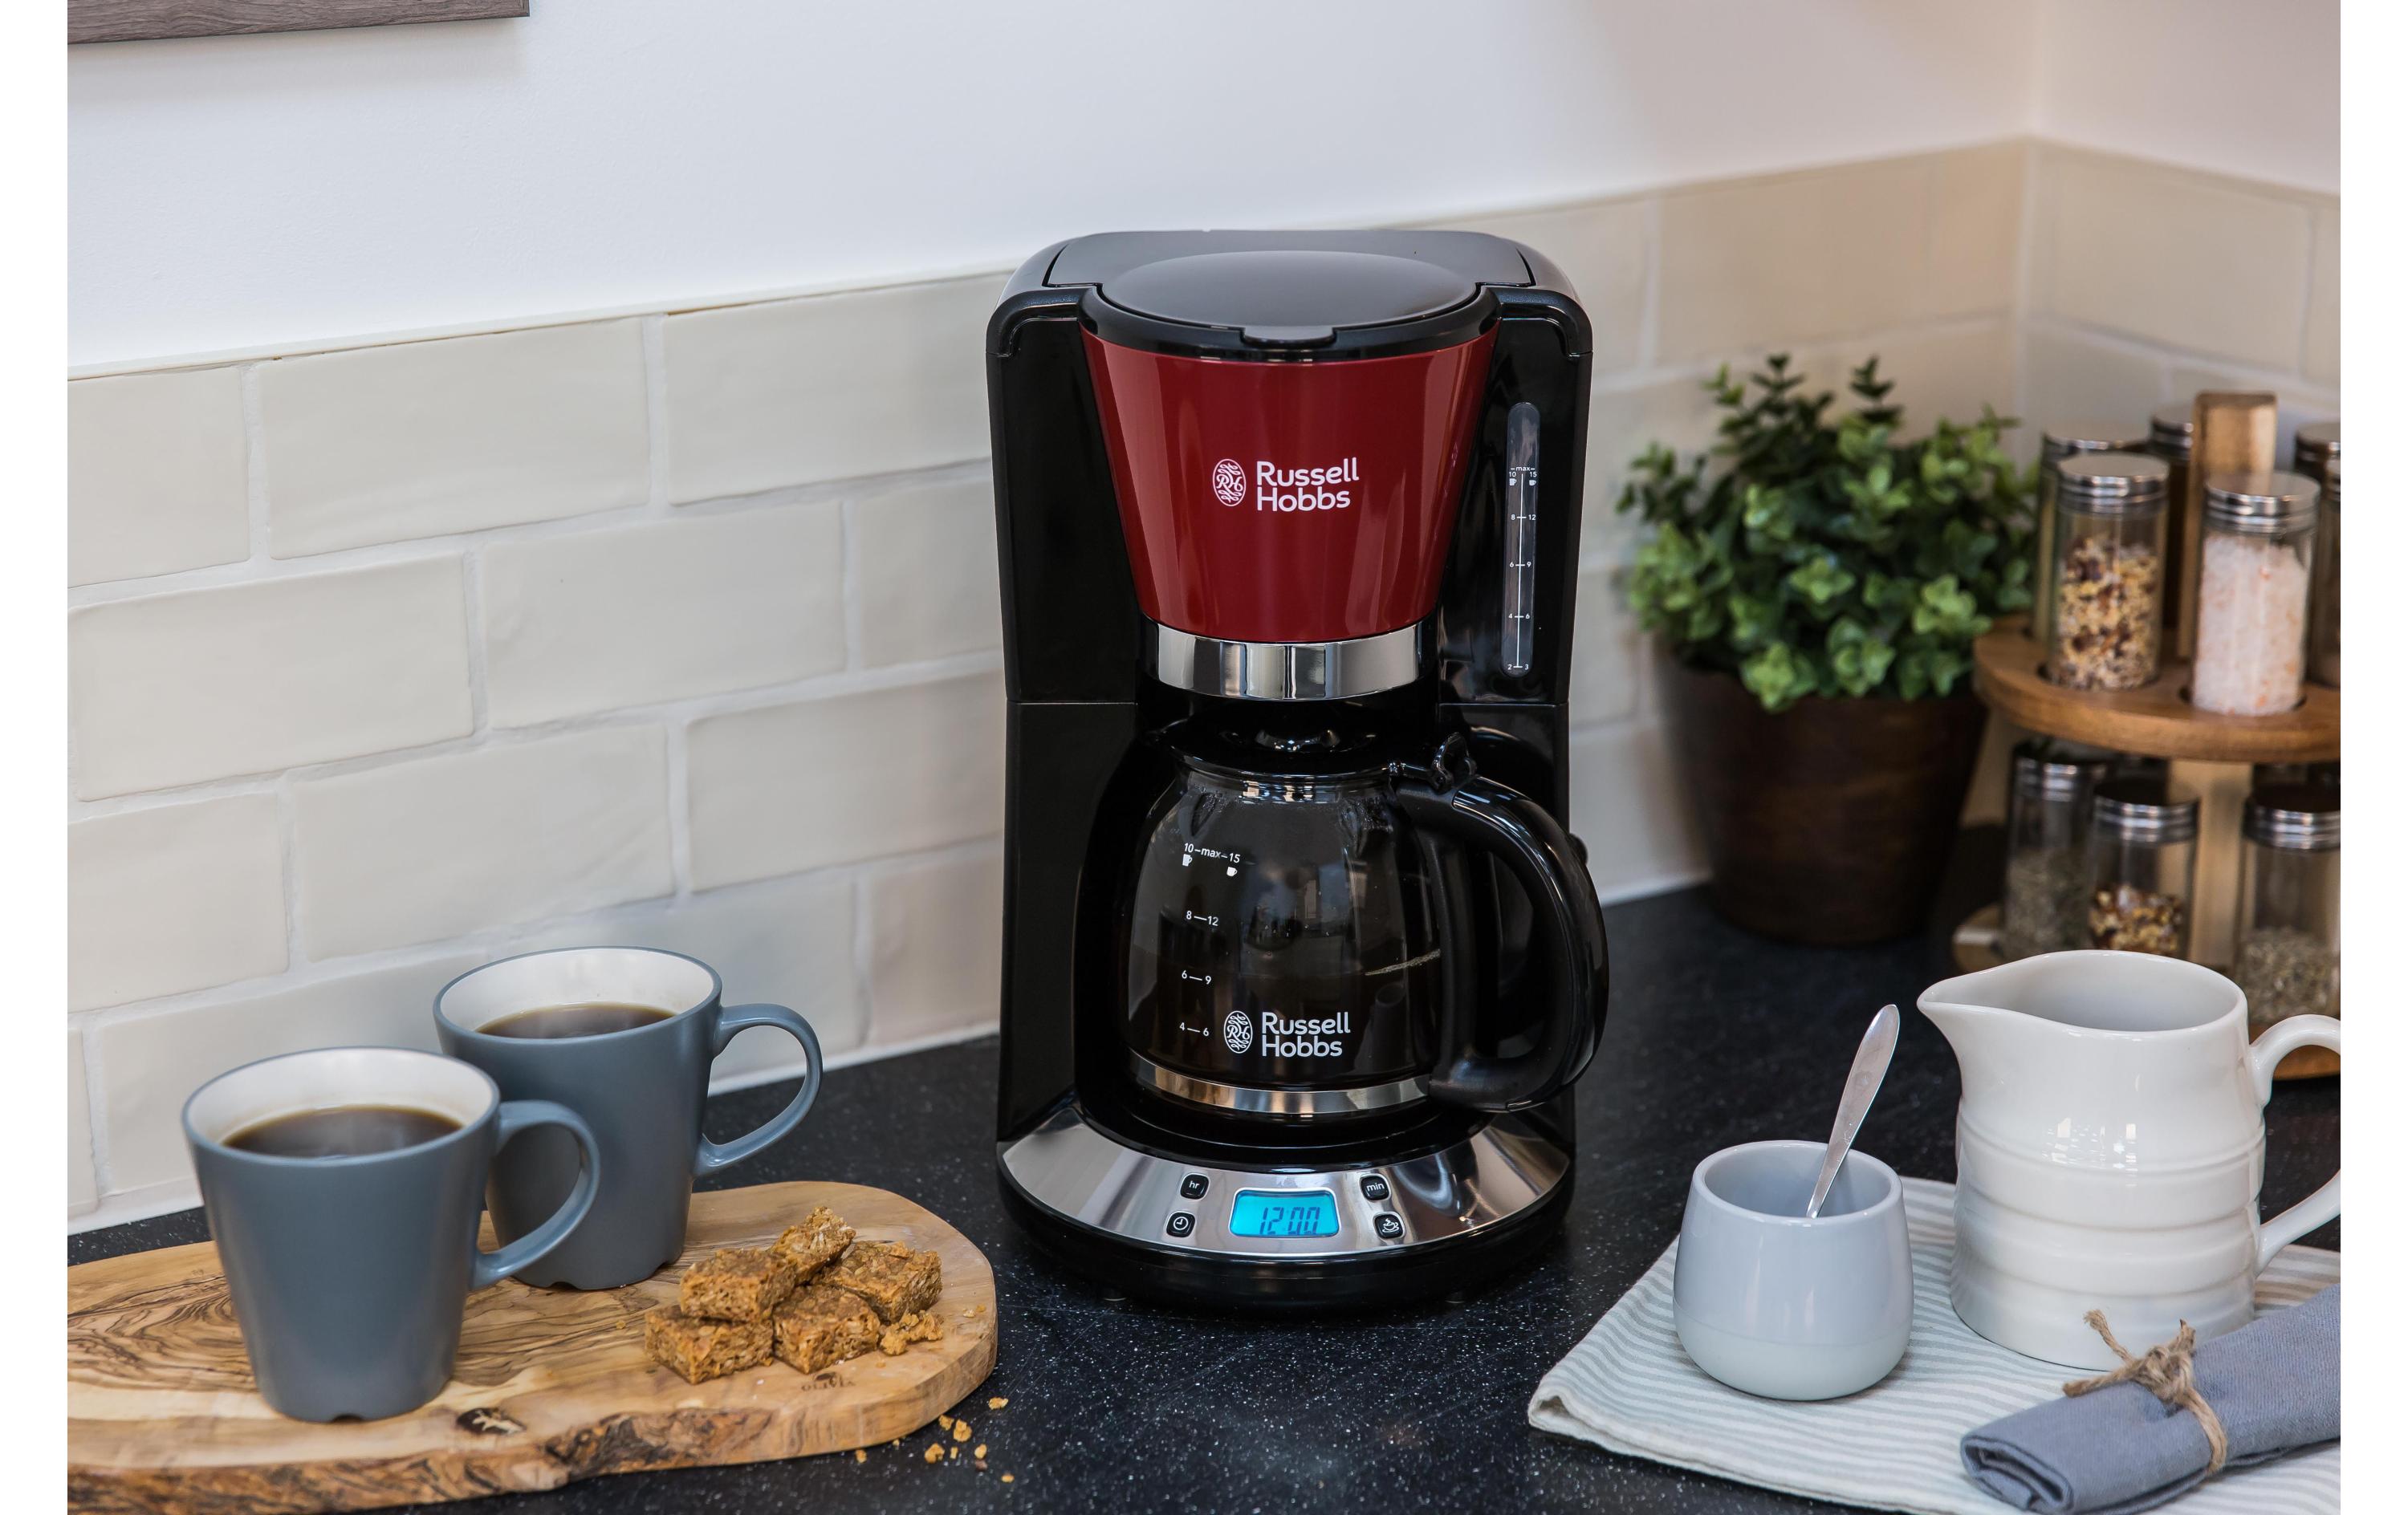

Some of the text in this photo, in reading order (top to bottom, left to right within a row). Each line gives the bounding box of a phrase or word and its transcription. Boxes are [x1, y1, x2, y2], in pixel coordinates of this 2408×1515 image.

[1256, 457, 1360, 487] Russell
[1257, 486, 1351, 512] Hobbs
[1184, 843, 1241, 863] 10 max 15
[1186, 910, 1219, 926] 8 12
[1182, 970, 1212, 985] 6 9
[1179, 1022, 1210, 1037] 4 6
[1262, 1011, 1351, 1034] Russell
[1262, 1035, 1343, 1058] Hobbs
[1189, 1180, 1200, 1189] hr
[1366, 1181, 1385, 1191] min
